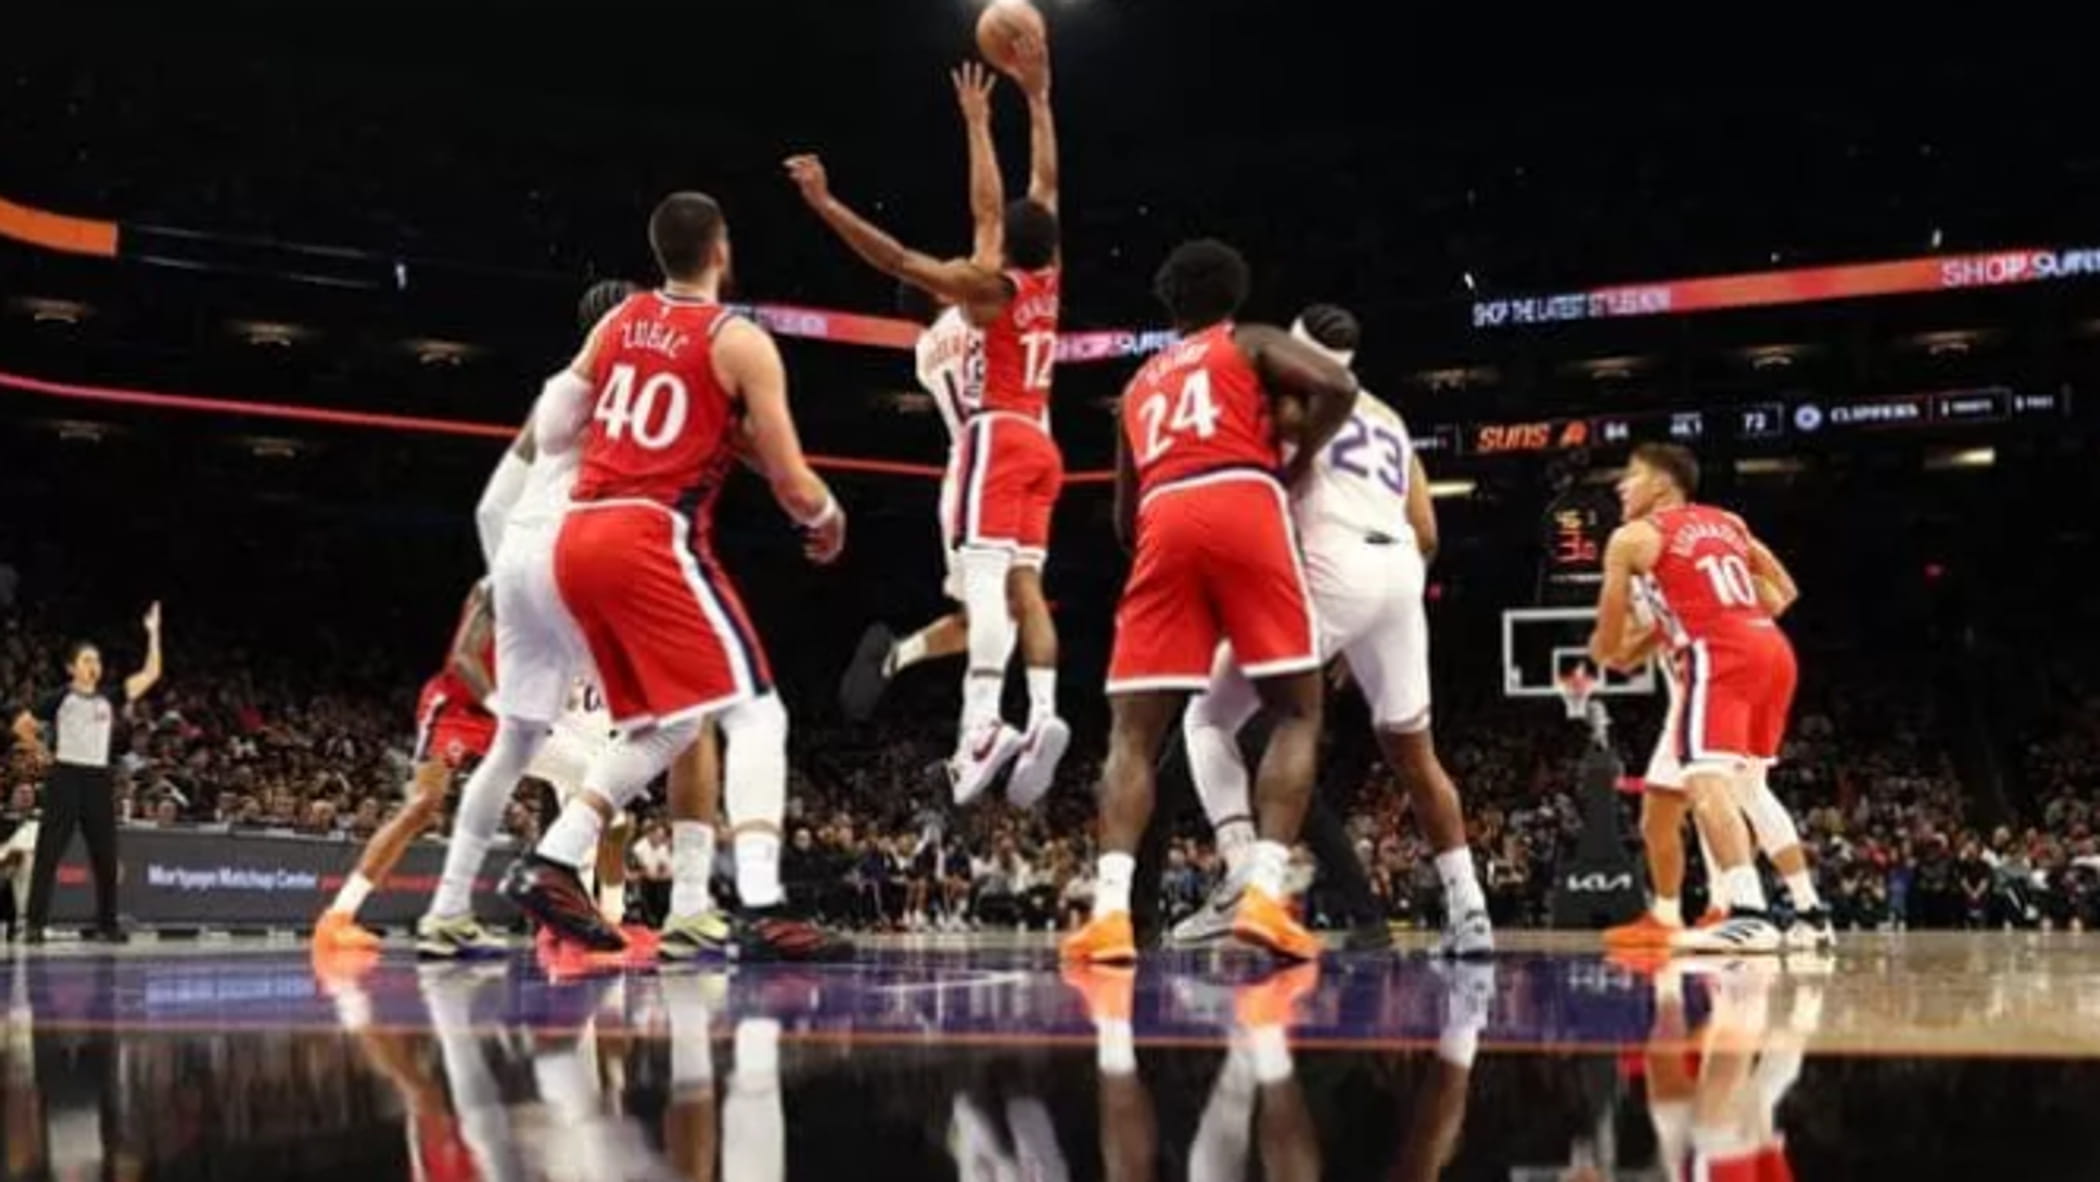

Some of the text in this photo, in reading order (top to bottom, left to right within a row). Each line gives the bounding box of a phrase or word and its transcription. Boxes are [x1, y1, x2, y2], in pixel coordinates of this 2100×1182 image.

[1018, 331, 1057, 391] 12
[593, 363, 689, 450] 40
[1139, 368, 1221, 463] 24
[1478, 423, 1550, 452] SUNS
[1329, 414, 1404, 496] 23
[1695, 554, 1757, 608] 10
